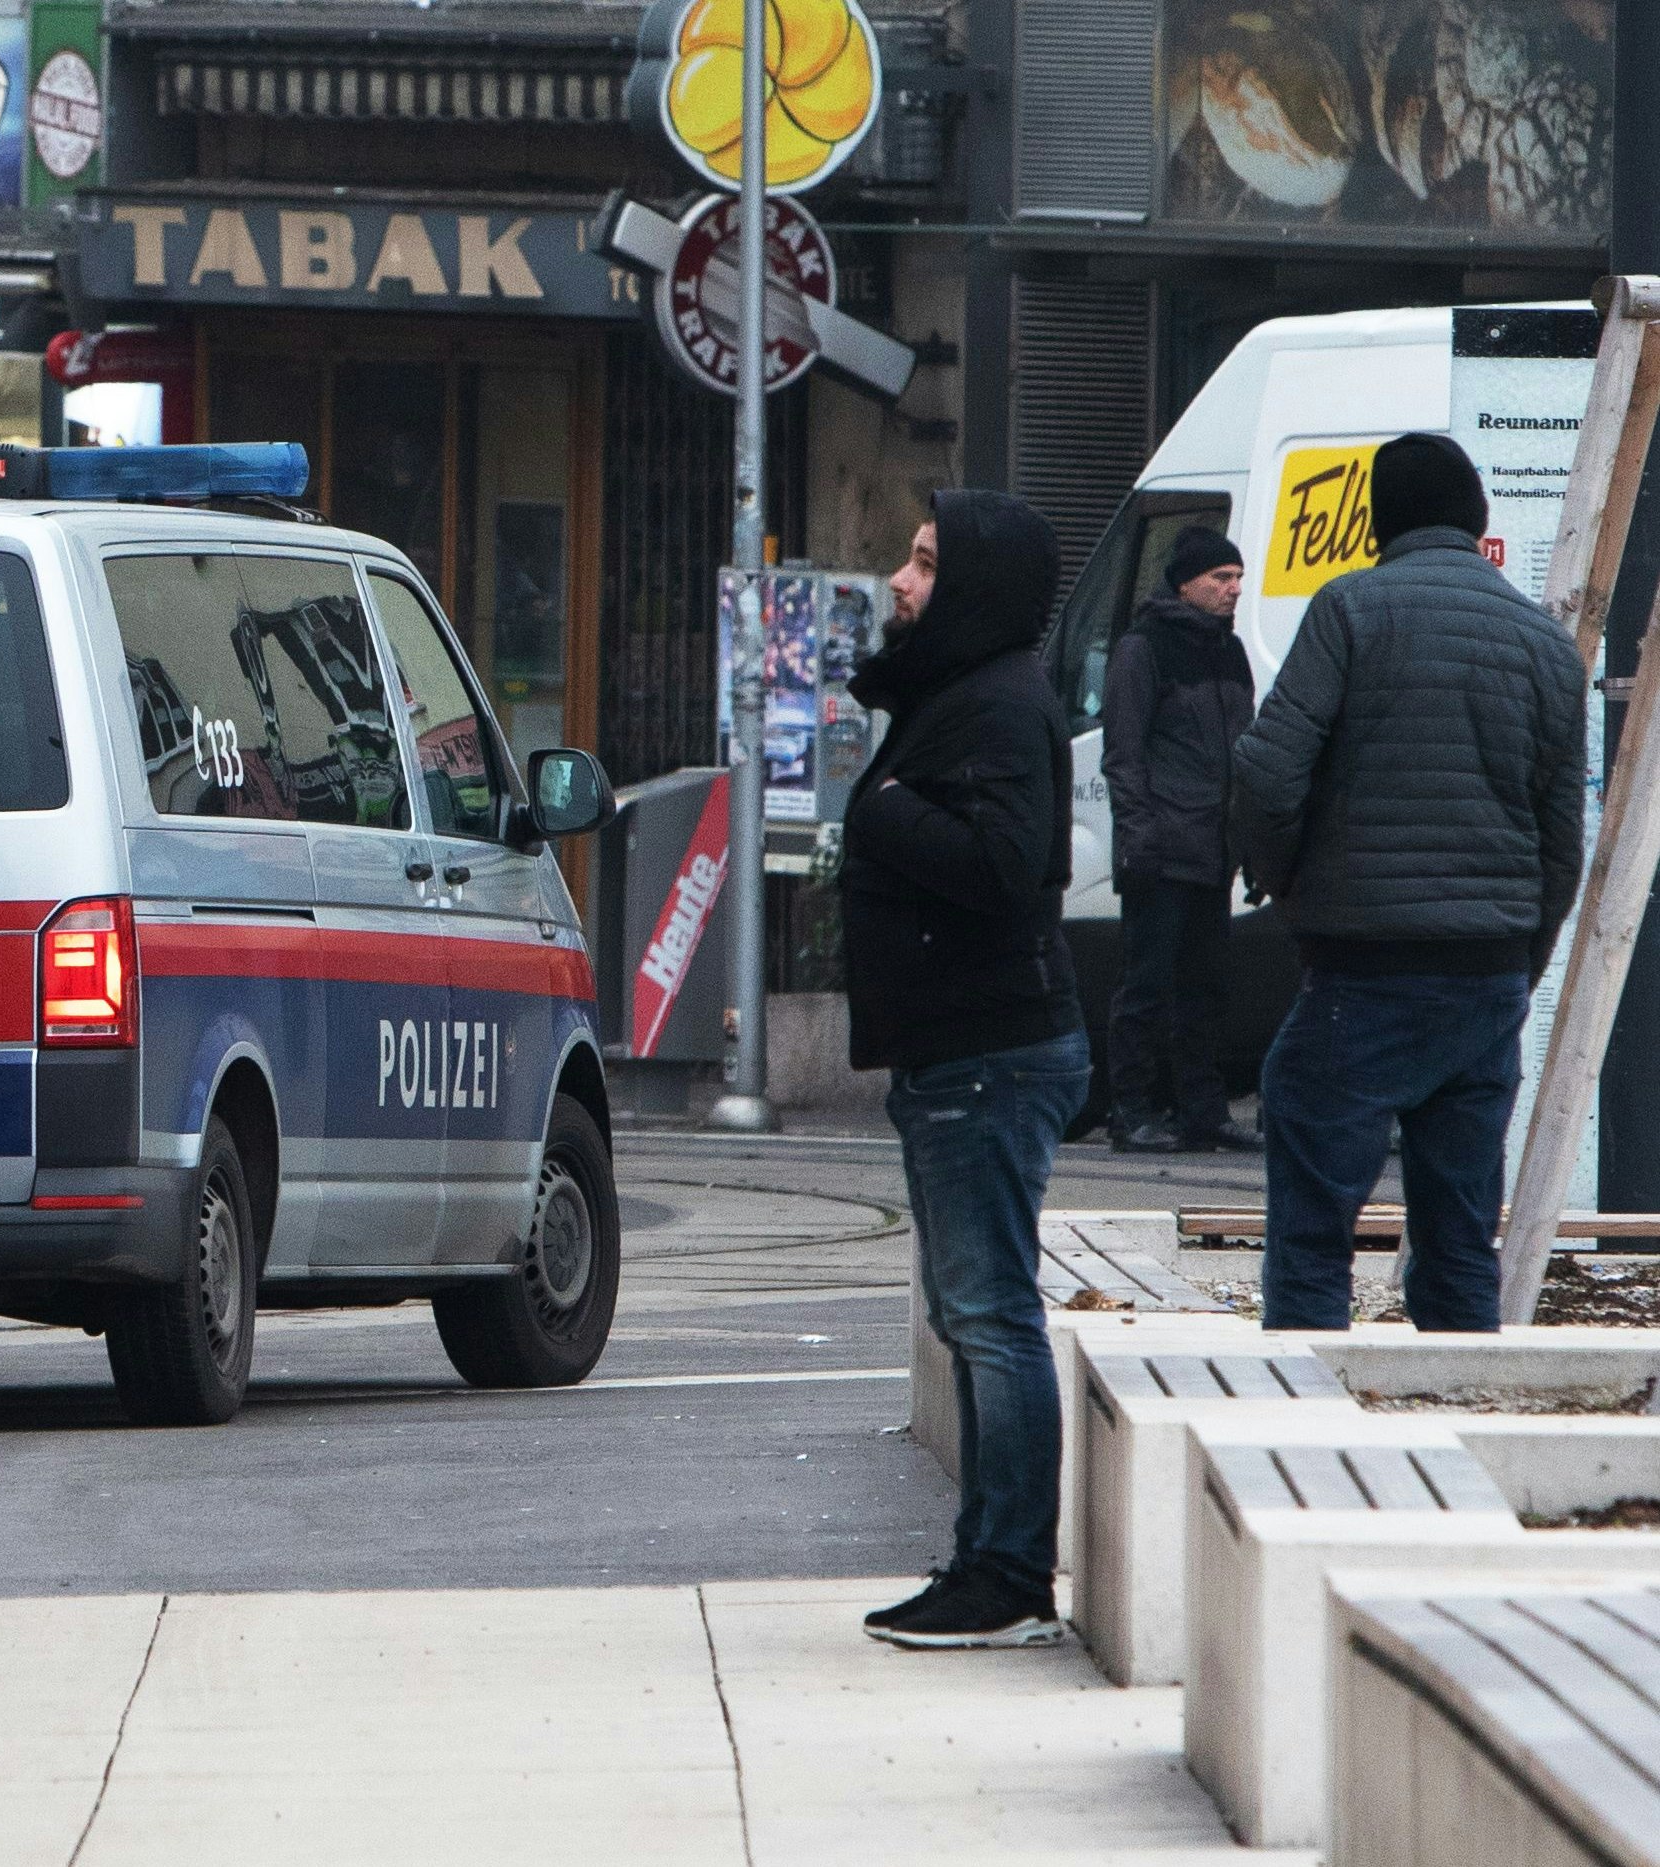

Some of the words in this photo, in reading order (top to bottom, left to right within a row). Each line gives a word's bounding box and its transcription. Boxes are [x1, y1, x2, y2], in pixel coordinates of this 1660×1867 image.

[113, 206, 544, 297] TABAK
[676, 276, 790, 378] TRAFK
[1478, 412, 1583, 430] Reumann
[205, 719, 244, 788] 133
[642, 853, 719, 990] Heute
[378, 1019, 498, 1109] POLIZEI
